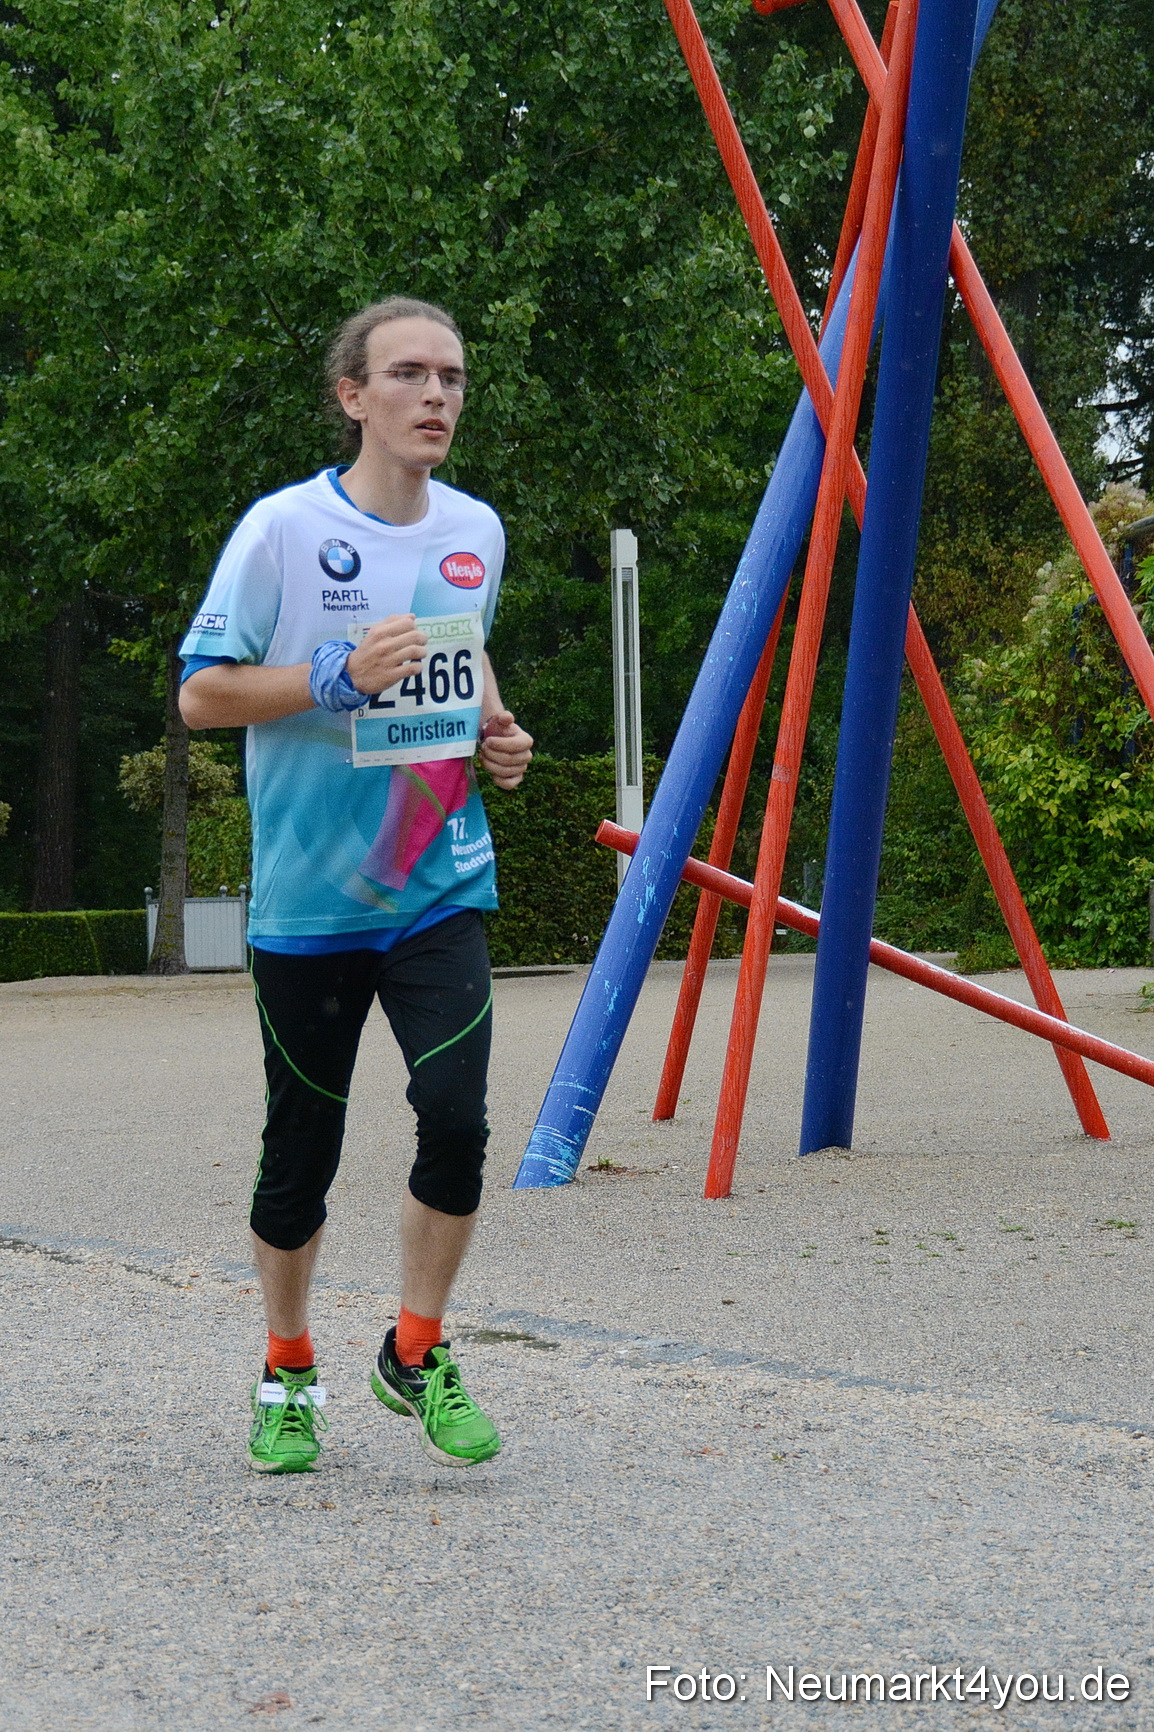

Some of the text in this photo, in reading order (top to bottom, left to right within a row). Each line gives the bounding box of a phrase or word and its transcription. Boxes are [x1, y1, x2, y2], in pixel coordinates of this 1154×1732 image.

[320, 539, 357, 554] BMW
[446, 561, 483, 580] Hervis
[322, 590, 369, 602] PARTL
[323, 602, 370, 612] Neumarkt
[192, 613, 228, 630] OCK
[357, 708, 365, 717] D
[387, 719, 467, 745] Christian
